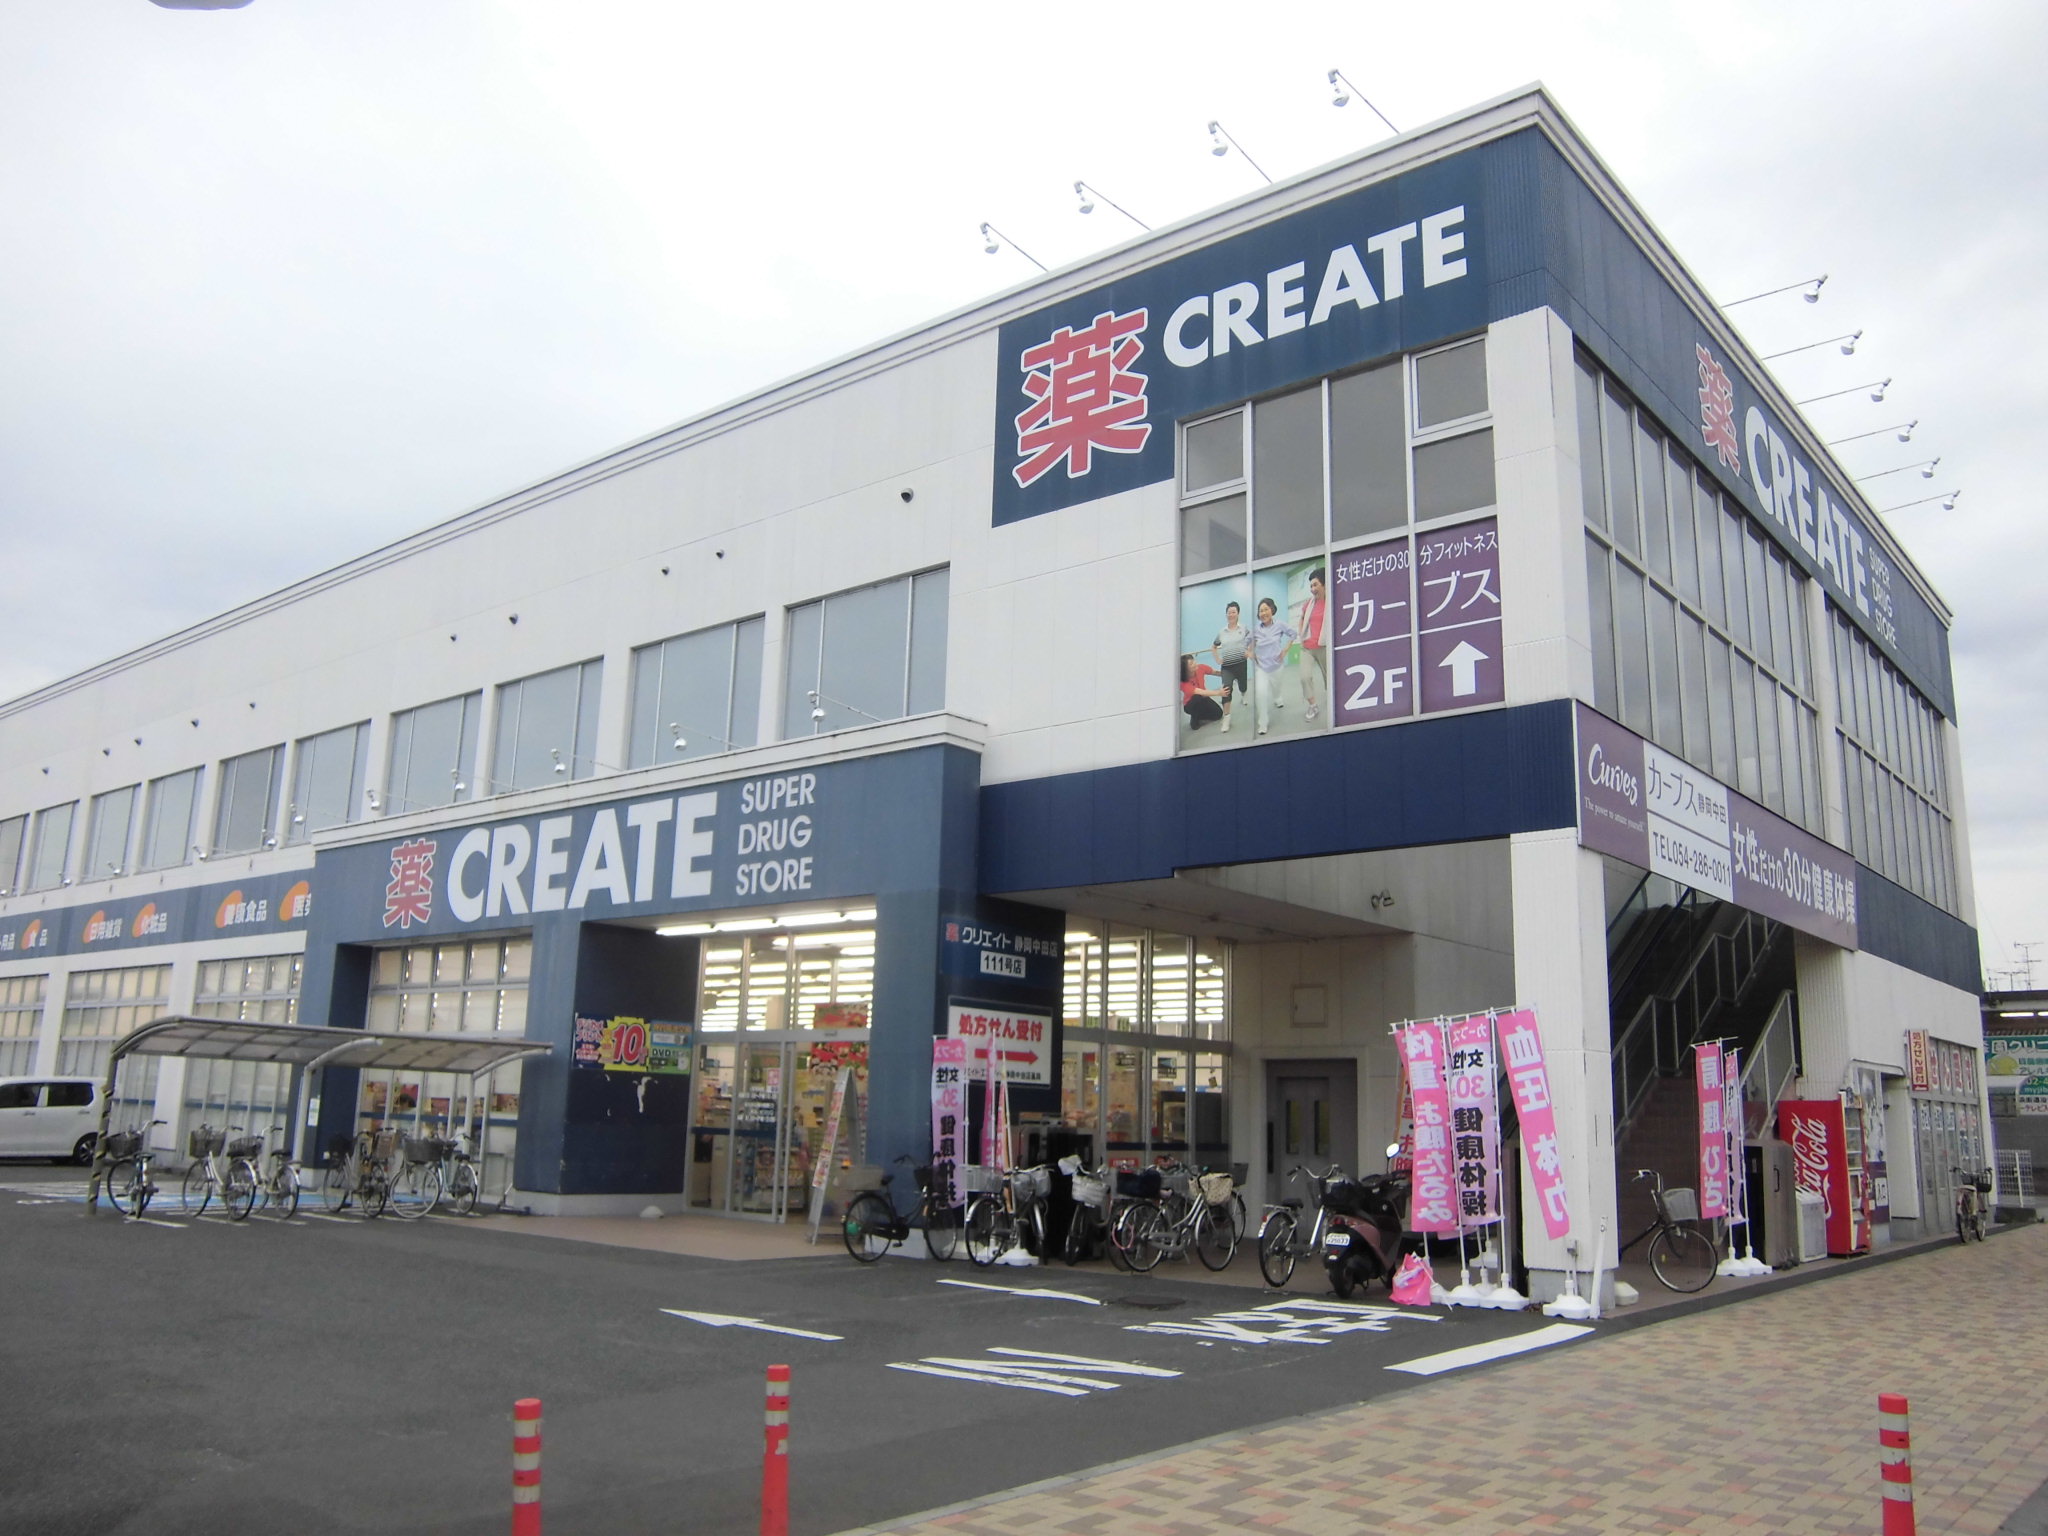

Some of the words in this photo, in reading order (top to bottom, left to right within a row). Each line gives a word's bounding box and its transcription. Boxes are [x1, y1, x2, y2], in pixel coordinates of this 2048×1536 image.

[1012, 307, 1152, 489] 薬
[1163, 205, 1468, 368] CREATE
[1696, 343, 1740, 477] 薬
[1745, 406, 1870, 618] CREATE
[1869, 547, 1890, 588] SUPER
[1341, 569, 1500, 635] カーブス
[1872, 580, 1893, 618] DRUG
[1875, 610, 1897, 650] STORE
[1344, 664, 1407, 710] 2F
[740, 772, 817, 815] SUPER
[1588, 744, 1638, 806] Curves
[1648, 758, 1698, 816] カーブス
[736, 815, 812, 855] DRUG
[383, 838, 436, 929] 薬
[446, 791, 719, 923] CREATE
[735, 856, 813, 896] STORE
[223, 899, 267, 927] 健康食品
[962, 926, 1011, 949] クリエイト
[983, 954, 1022, 974] 111号店
[959, 1013, 1043, 1042] 処方せん受付
